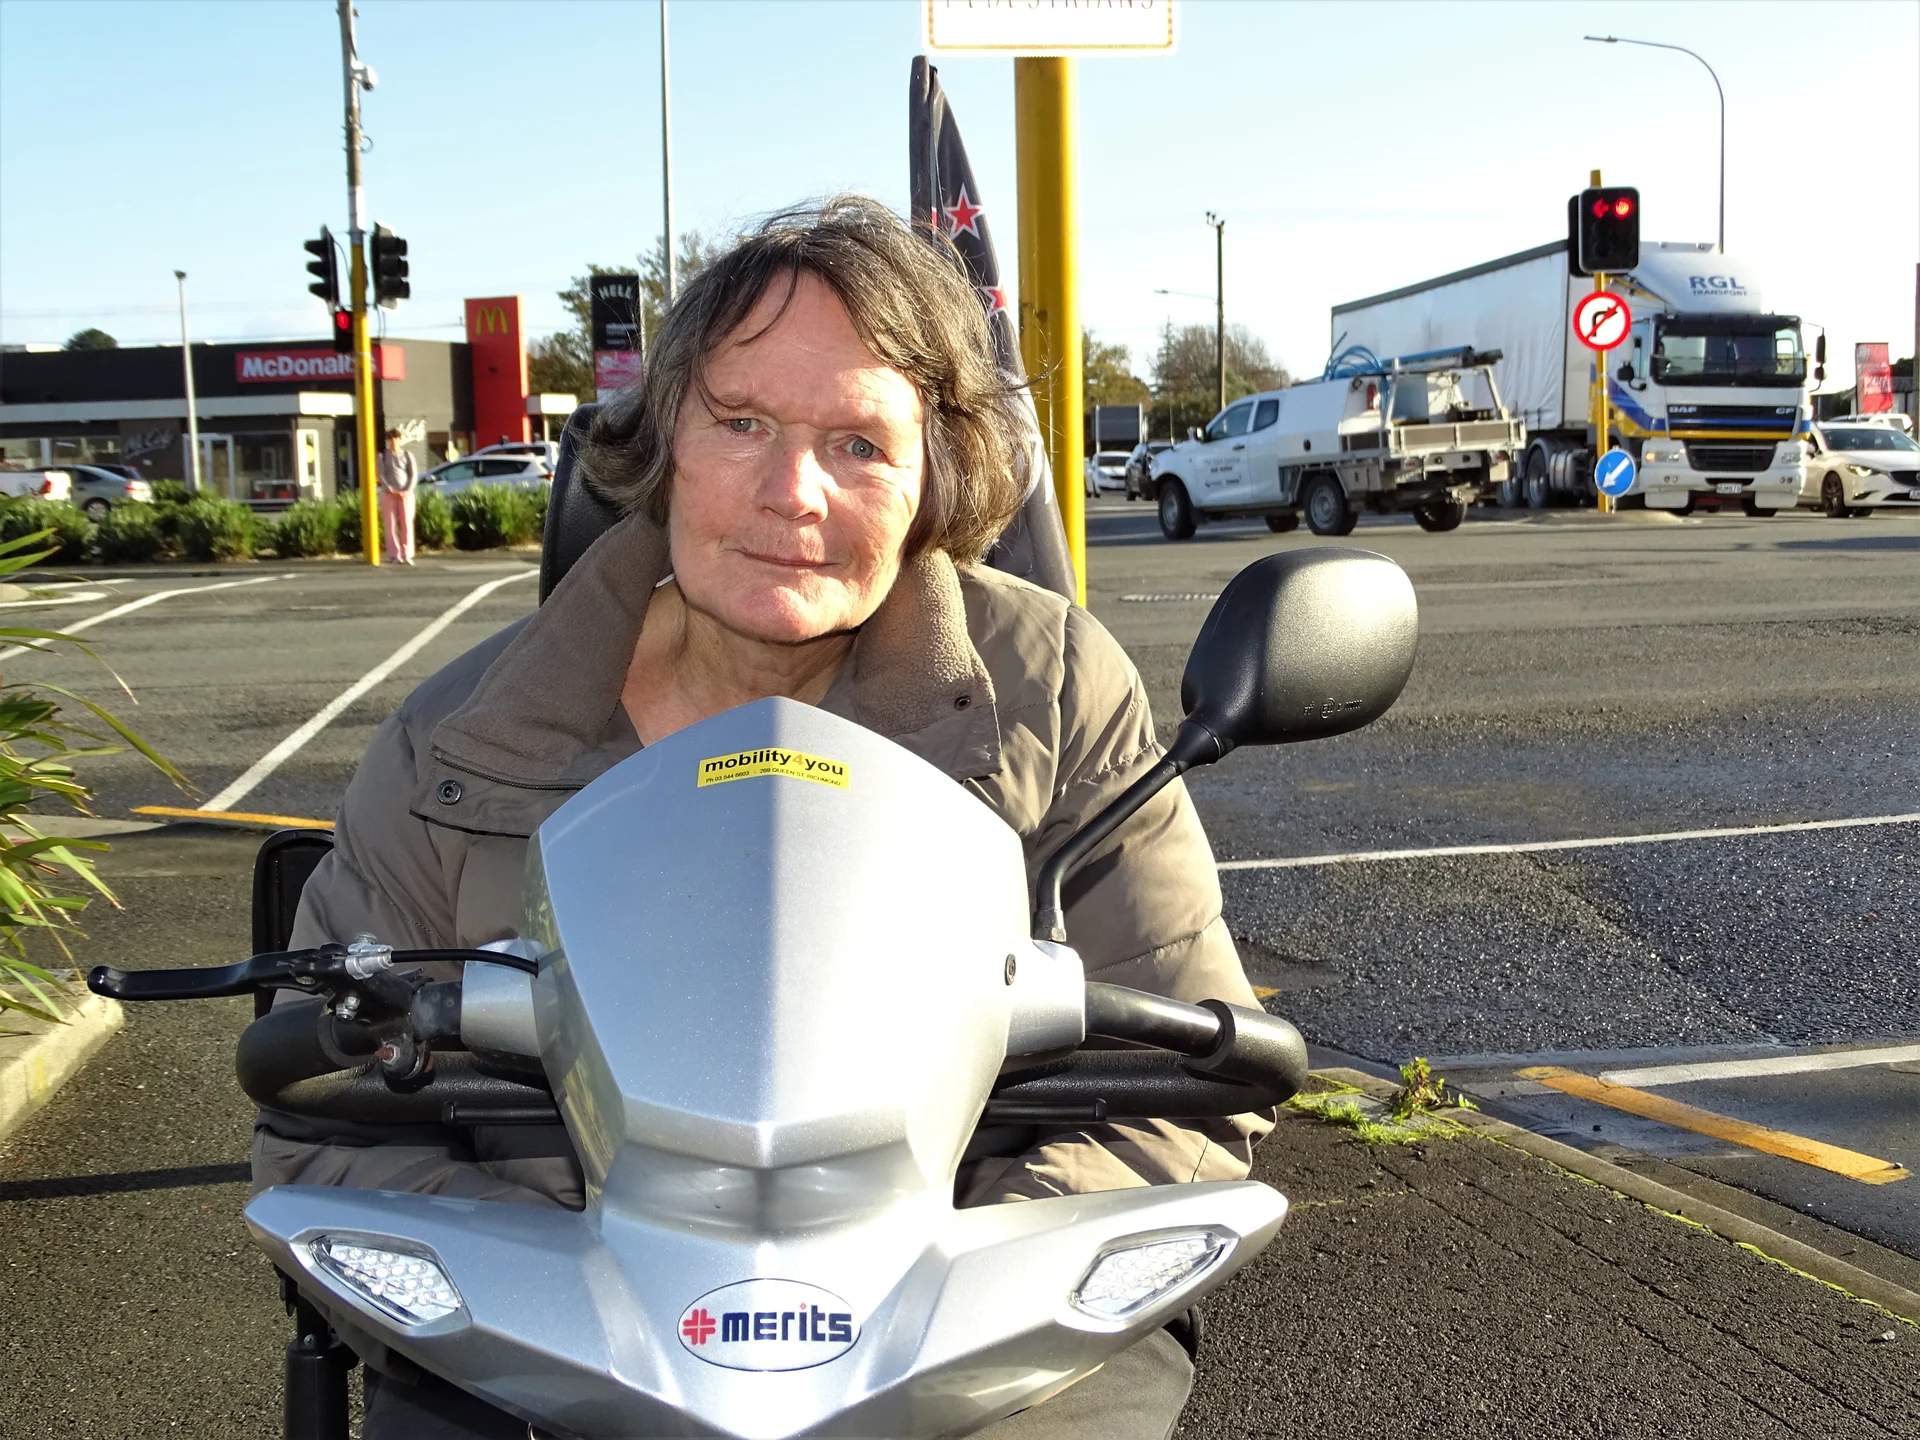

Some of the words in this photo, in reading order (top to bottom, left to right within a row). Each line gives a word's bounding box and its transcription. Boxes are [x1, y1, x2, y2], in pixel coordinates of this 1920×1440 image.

[598, 284, 632, 300] HELL
[1689, 276, 1745, 289] RGL
[242, 352, 377, 377] McDonalds
[705, 750, 844, 776] mobility4you
[771, 767, 795, 776] QUEEN
[806, 773, 841, 786] RICHMOND
[722, 1302, 852, 1343] merits
